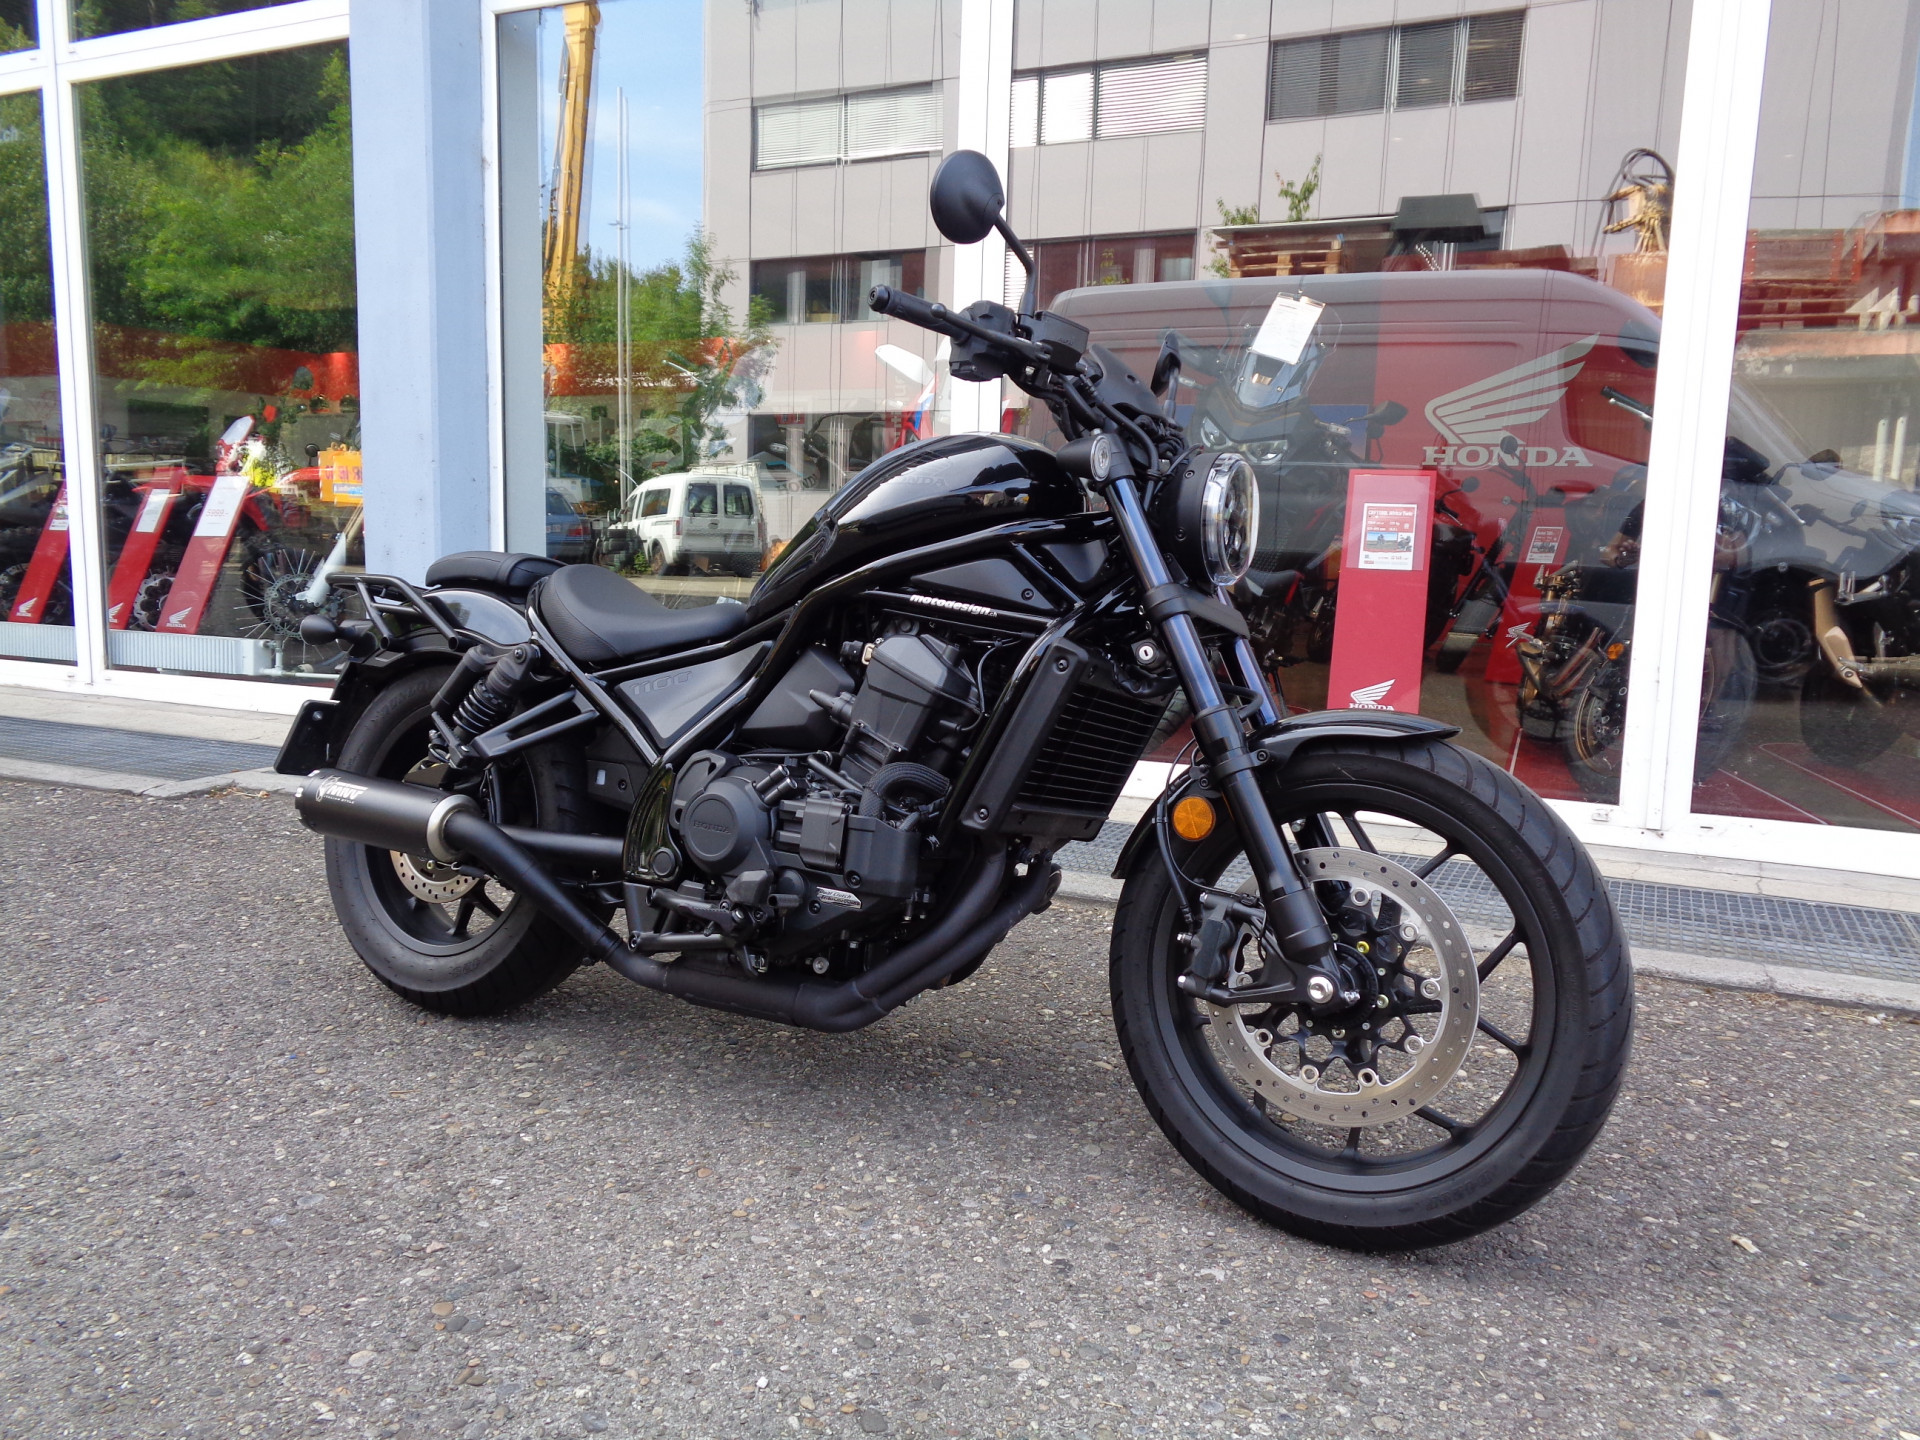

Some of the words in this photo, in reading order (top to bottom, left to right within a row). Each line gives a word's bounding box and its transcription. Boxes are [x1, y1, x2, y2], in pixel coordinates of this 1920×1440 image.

[1422, 446, 1593, 467] HONDA
[629, 670, 693, 695] 1100
[1349, 702, 1395, 711] HONDA
